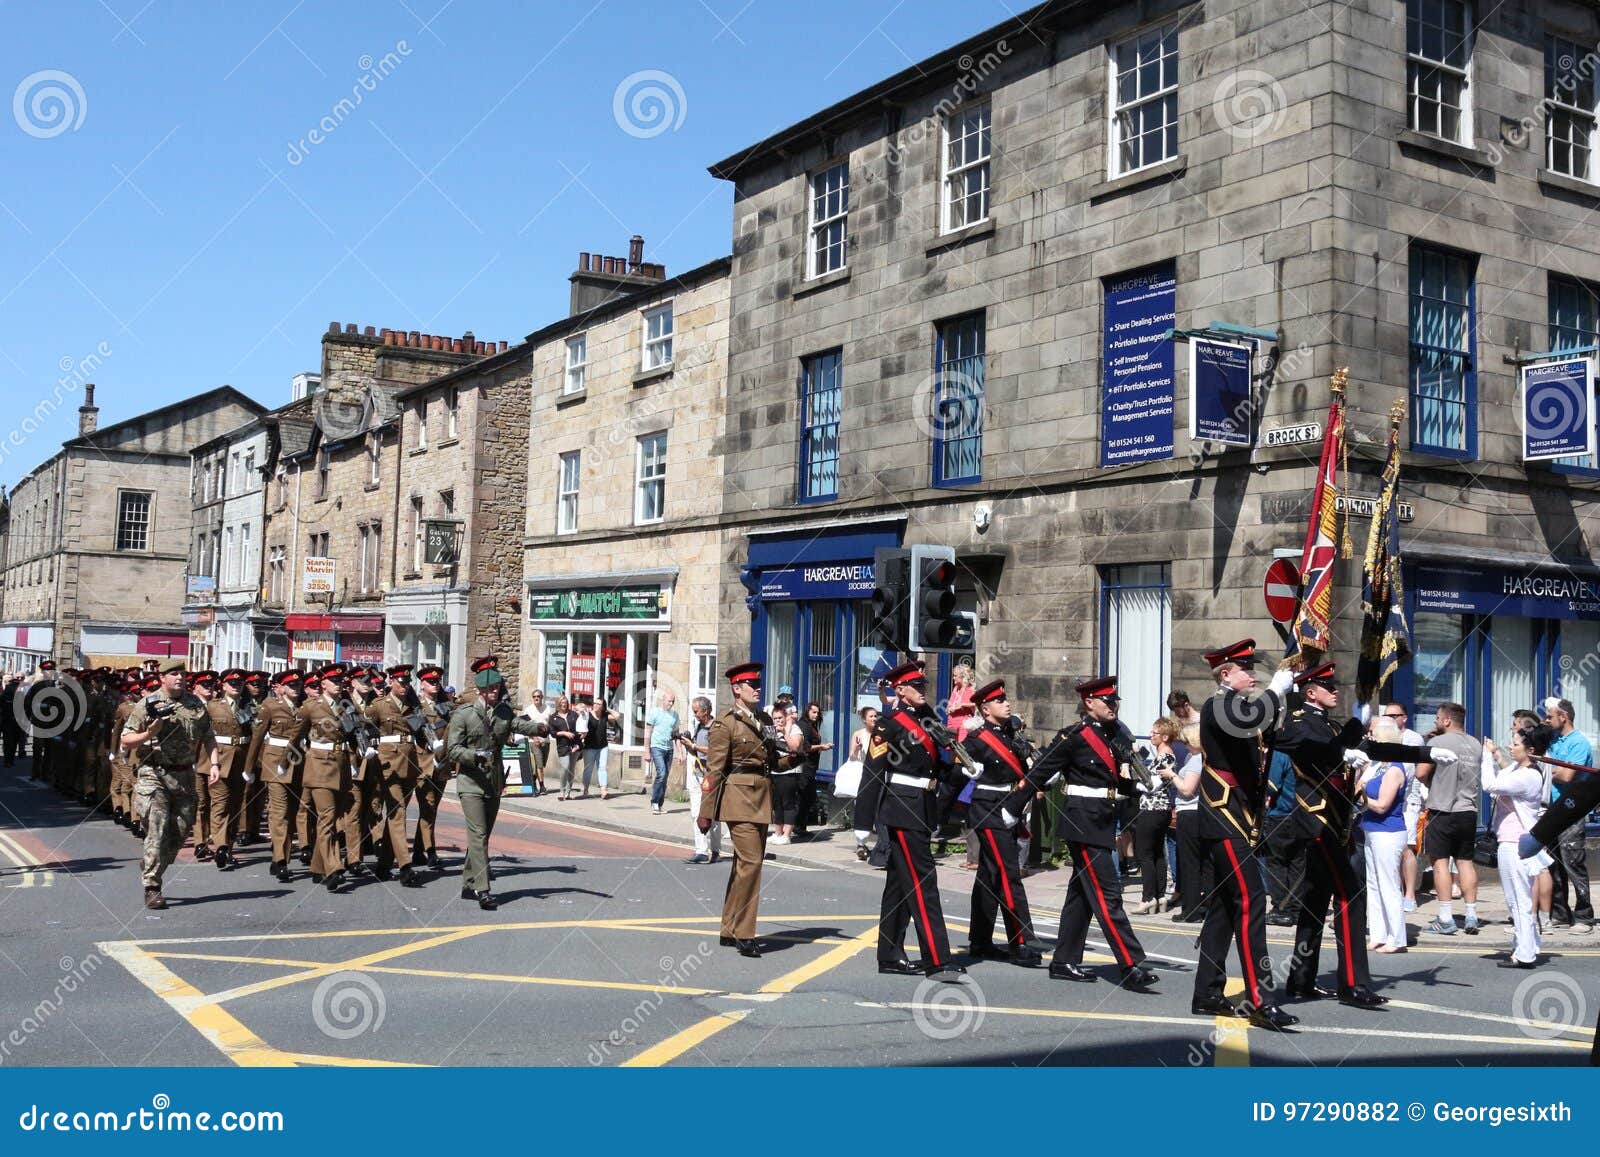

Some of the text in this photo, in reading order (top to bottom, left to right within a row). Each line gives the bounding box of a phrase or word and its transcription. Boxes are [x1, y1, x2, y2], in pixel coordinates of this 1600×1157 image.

[1114, 312, 1176, 332] Share Dealing Services
[1114, 338, 1138, 349] Portfolio
[1114, 352, 1149, 366] Self Invested
[1114, 361, 1162, 376] Personal Pensions
[1123, 381, 1147, 393] Portfolio
[1148, 377, 1171, 388] Services
[1112, 395, 1173, 412] Charity/Trust Portfolio
[1112, 406, 1173, 422] Management Services
[1108, 434, 1155, 448] Tel 01524 541 560
[1268, 428, 1302, 443] BROCK
[429, 536, 442, 546] 23
[305, 566, 333, 574] Marvin
[608, 663, 620, 673] YOU
